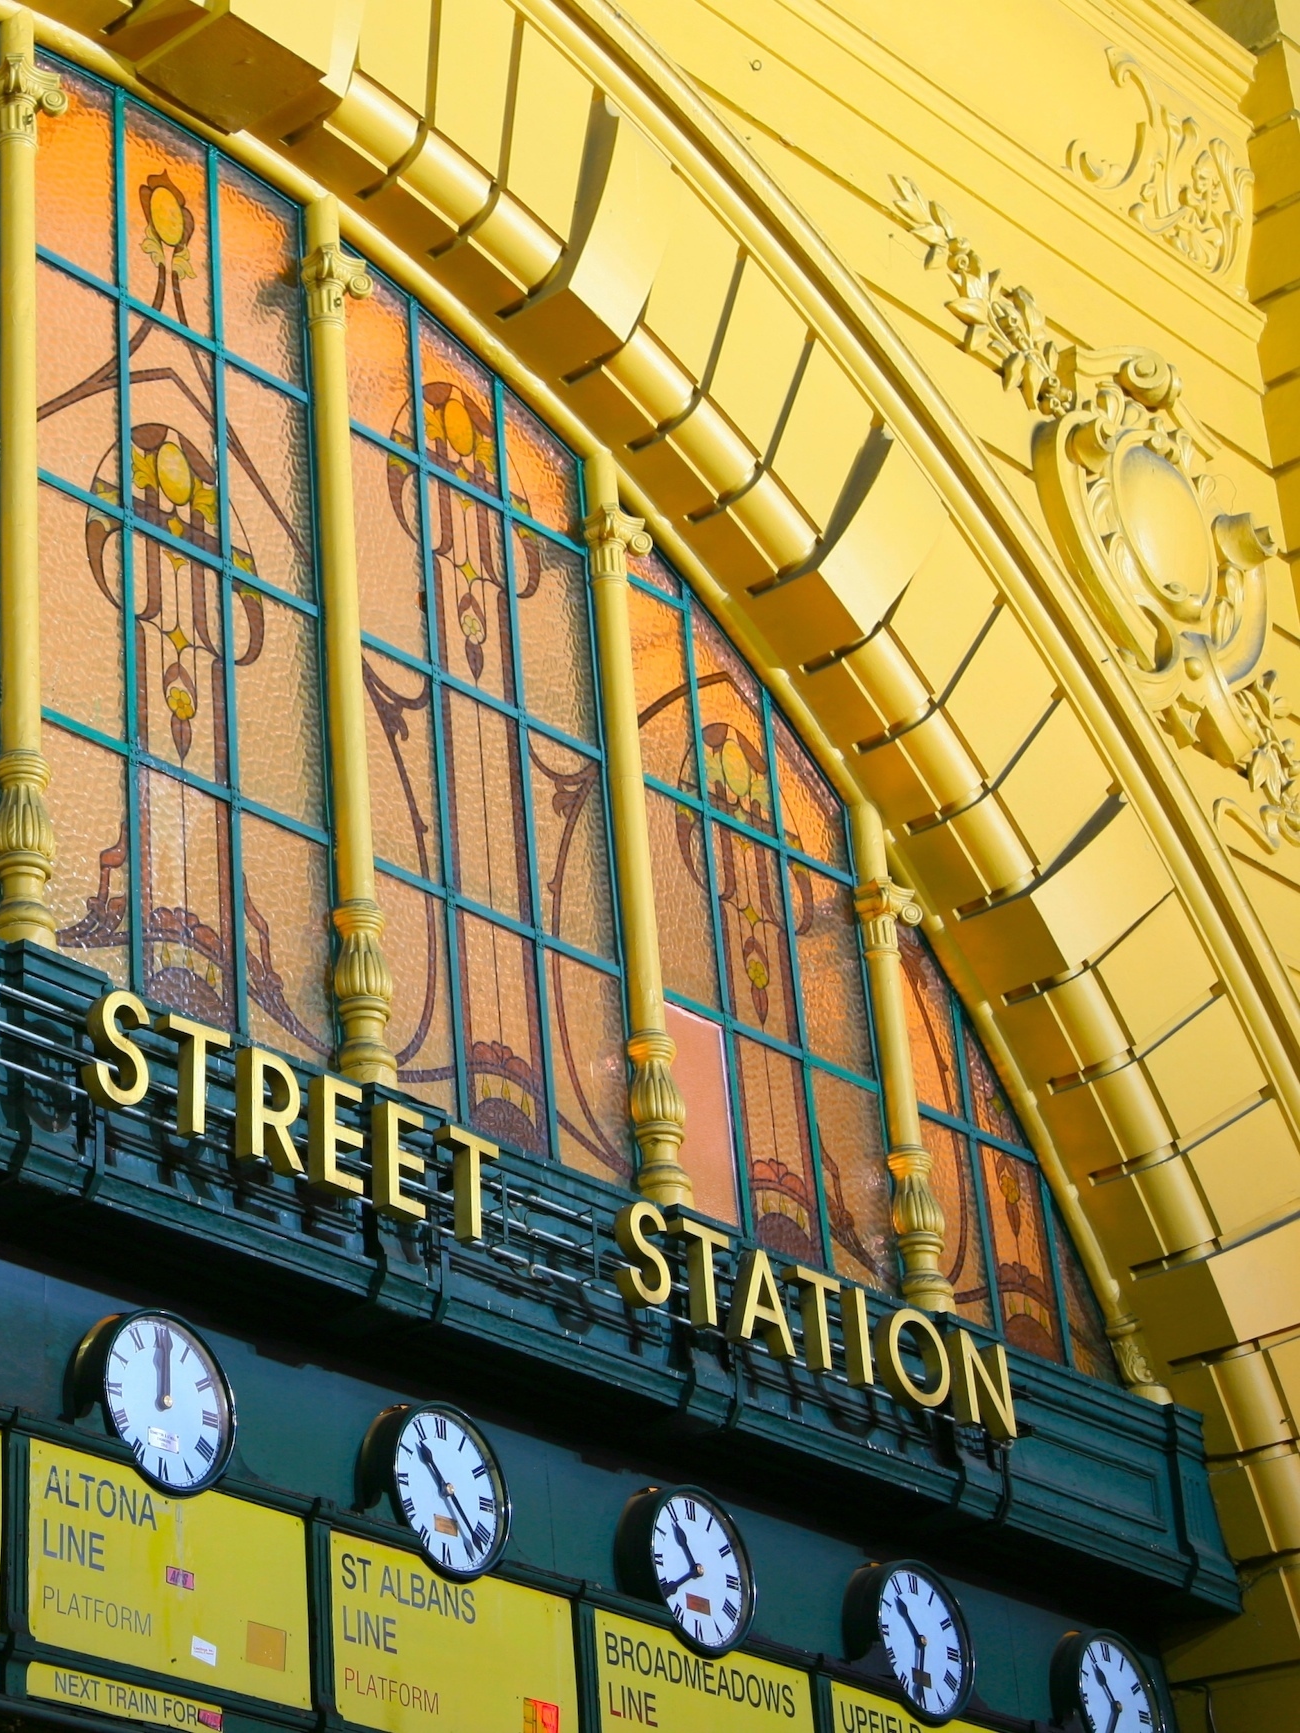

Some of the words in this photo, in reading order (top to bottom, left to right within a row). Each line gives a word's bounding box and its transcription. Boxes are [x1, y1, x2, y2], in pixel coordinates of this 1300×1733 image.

[81, 990, 498, 1245] STREET
[614, 1201, 1017, 1440] STATION
[44, 1465, 158, 1531] ALTONA
[42, 1519, 104, 1573] LINE
[42, 1585, 152, 1637] PLATFORM
[341, 1553, 372, 1594] ST
[380, 1563, 476, 1624] ALBANS
[343, 1604, 397, 1655] LINE
[54, 1671, 101, 1702] NEXT
[105, 1683, 157, 1716] TRAIN
[163, 1698, 198, 1727] FOR
[344, 1667, 440, 1715] PLATFORM
[604, 1631, 796, 1718] BROADMEADOWS
[608, 1681, 658, 1728] LINE
